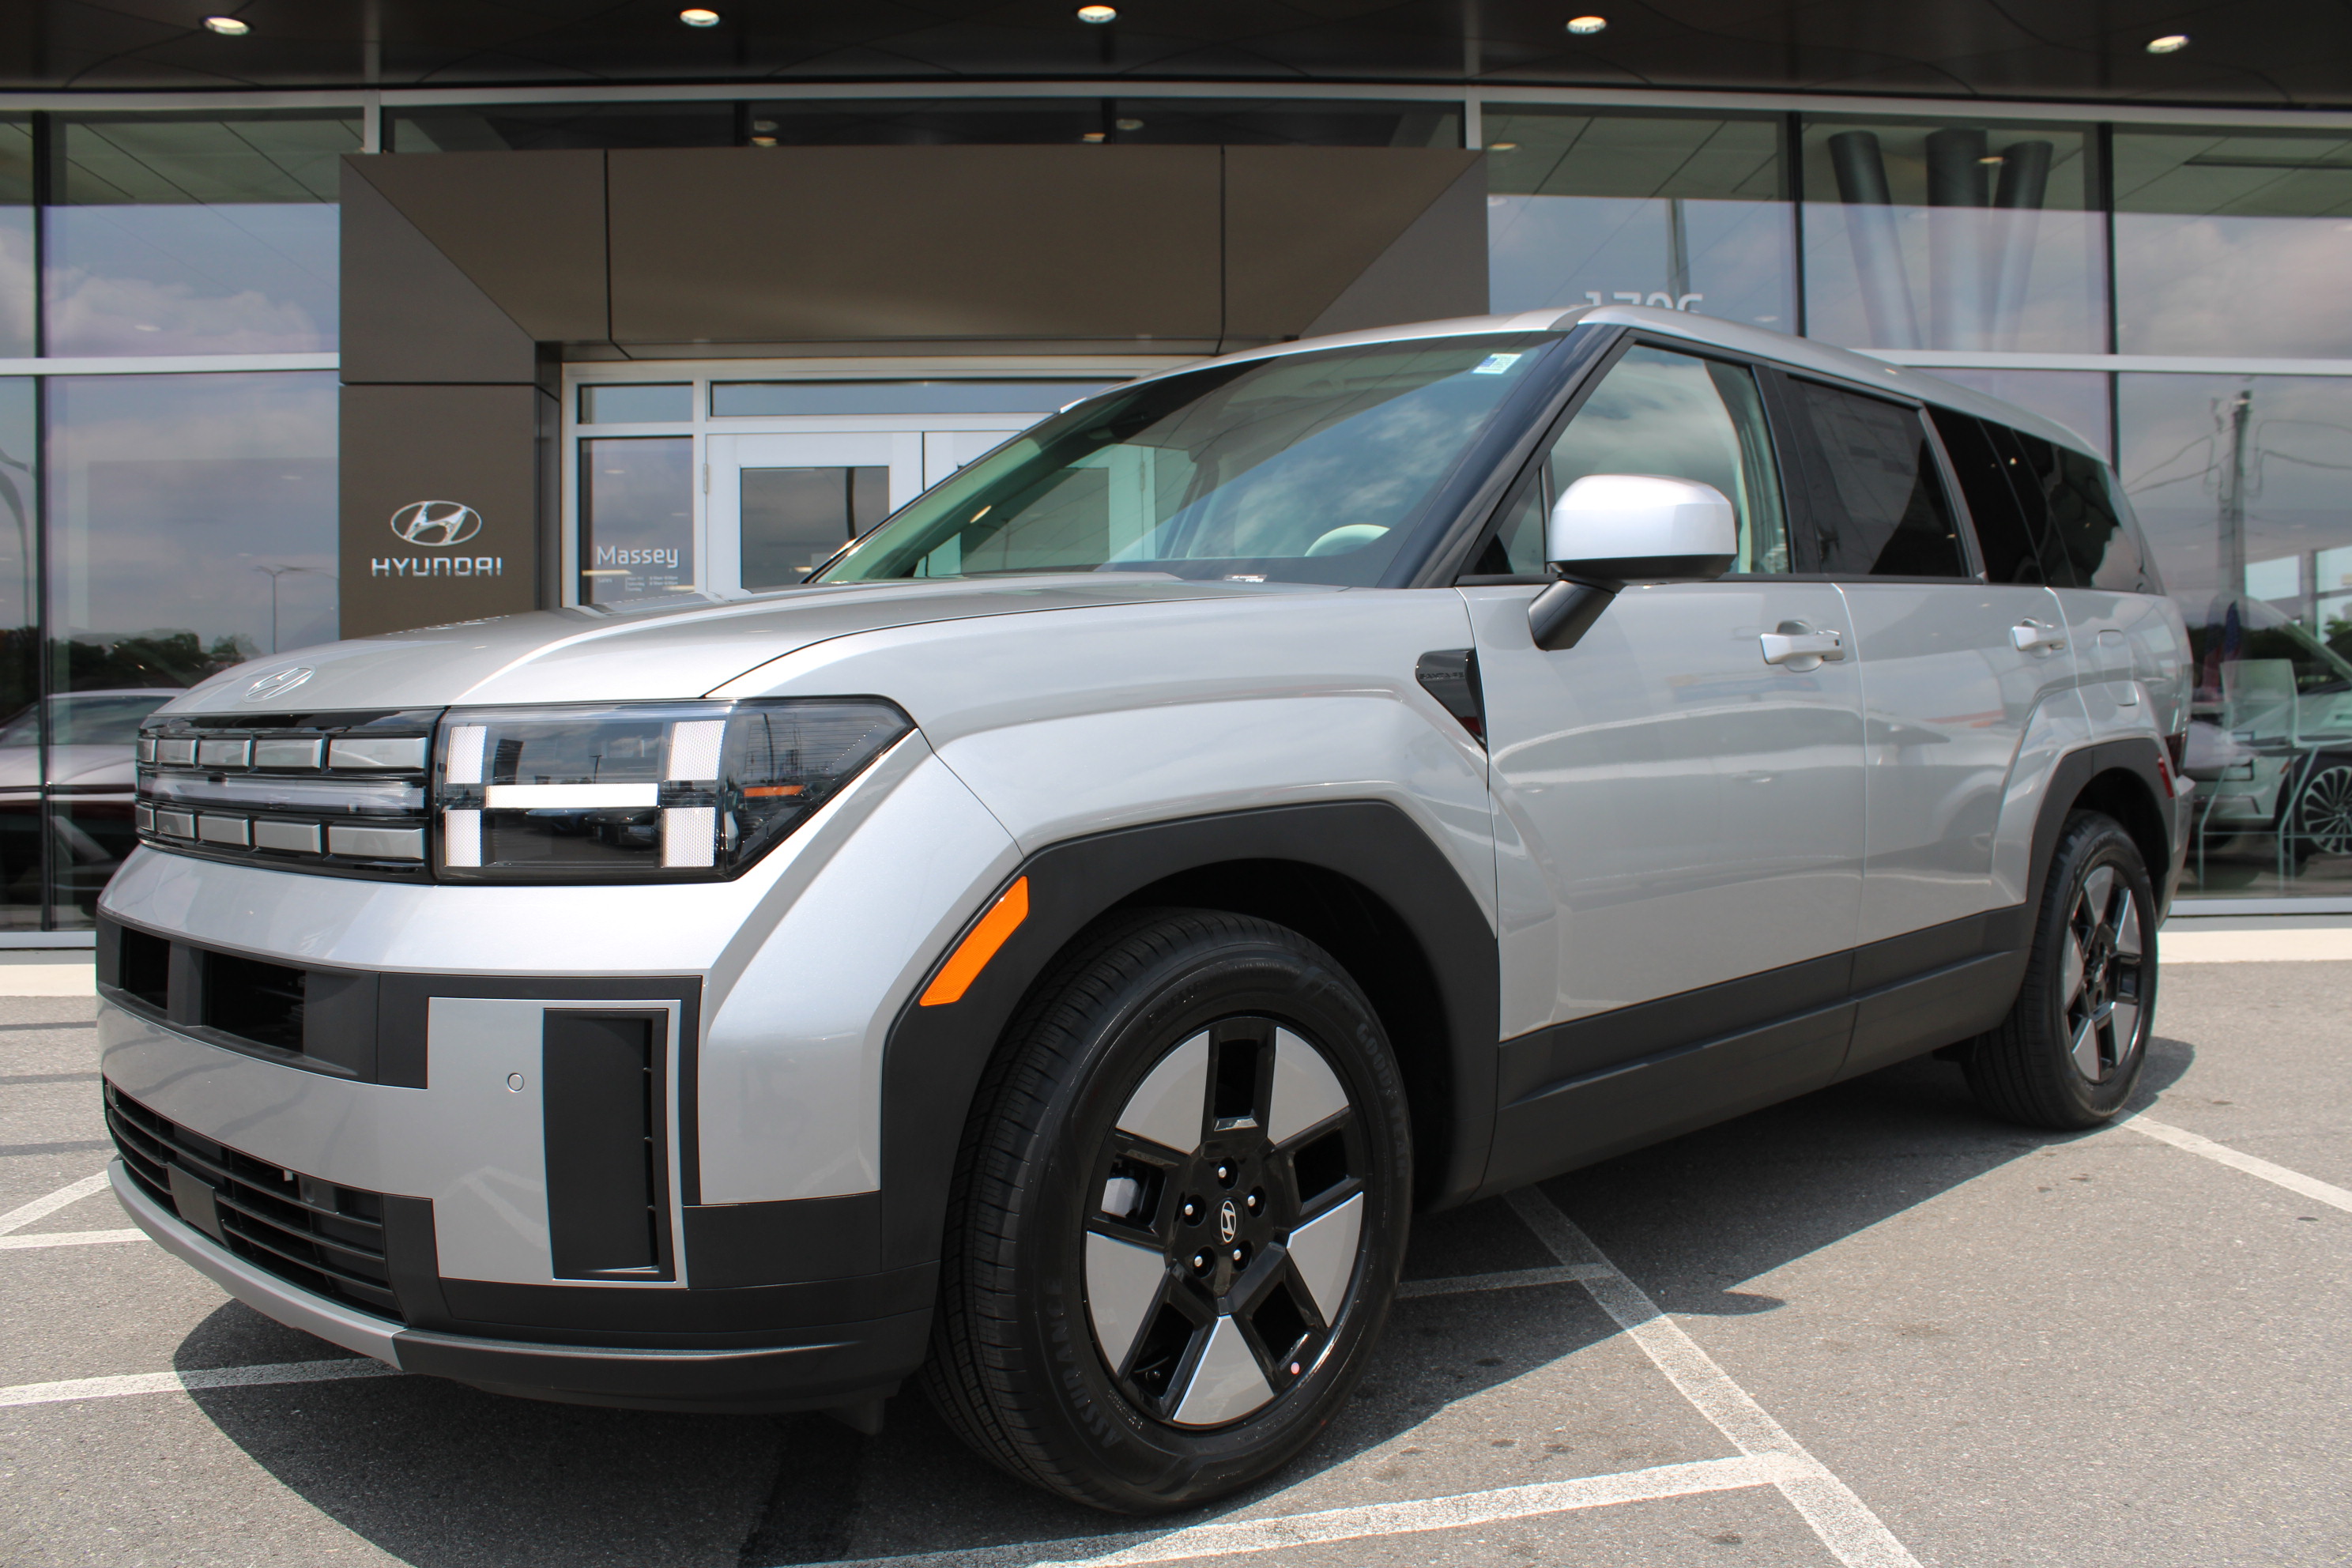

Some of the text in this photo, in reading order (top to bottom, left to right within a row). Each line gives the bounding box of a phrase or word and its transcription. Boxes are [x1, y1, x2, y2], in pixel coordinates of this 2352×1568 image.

[371, 557, 502, 576] HYUNDAI
[597, 545, 679, 568] Massey
[1046, 1277, 1122, 1449] ASSURANCE
